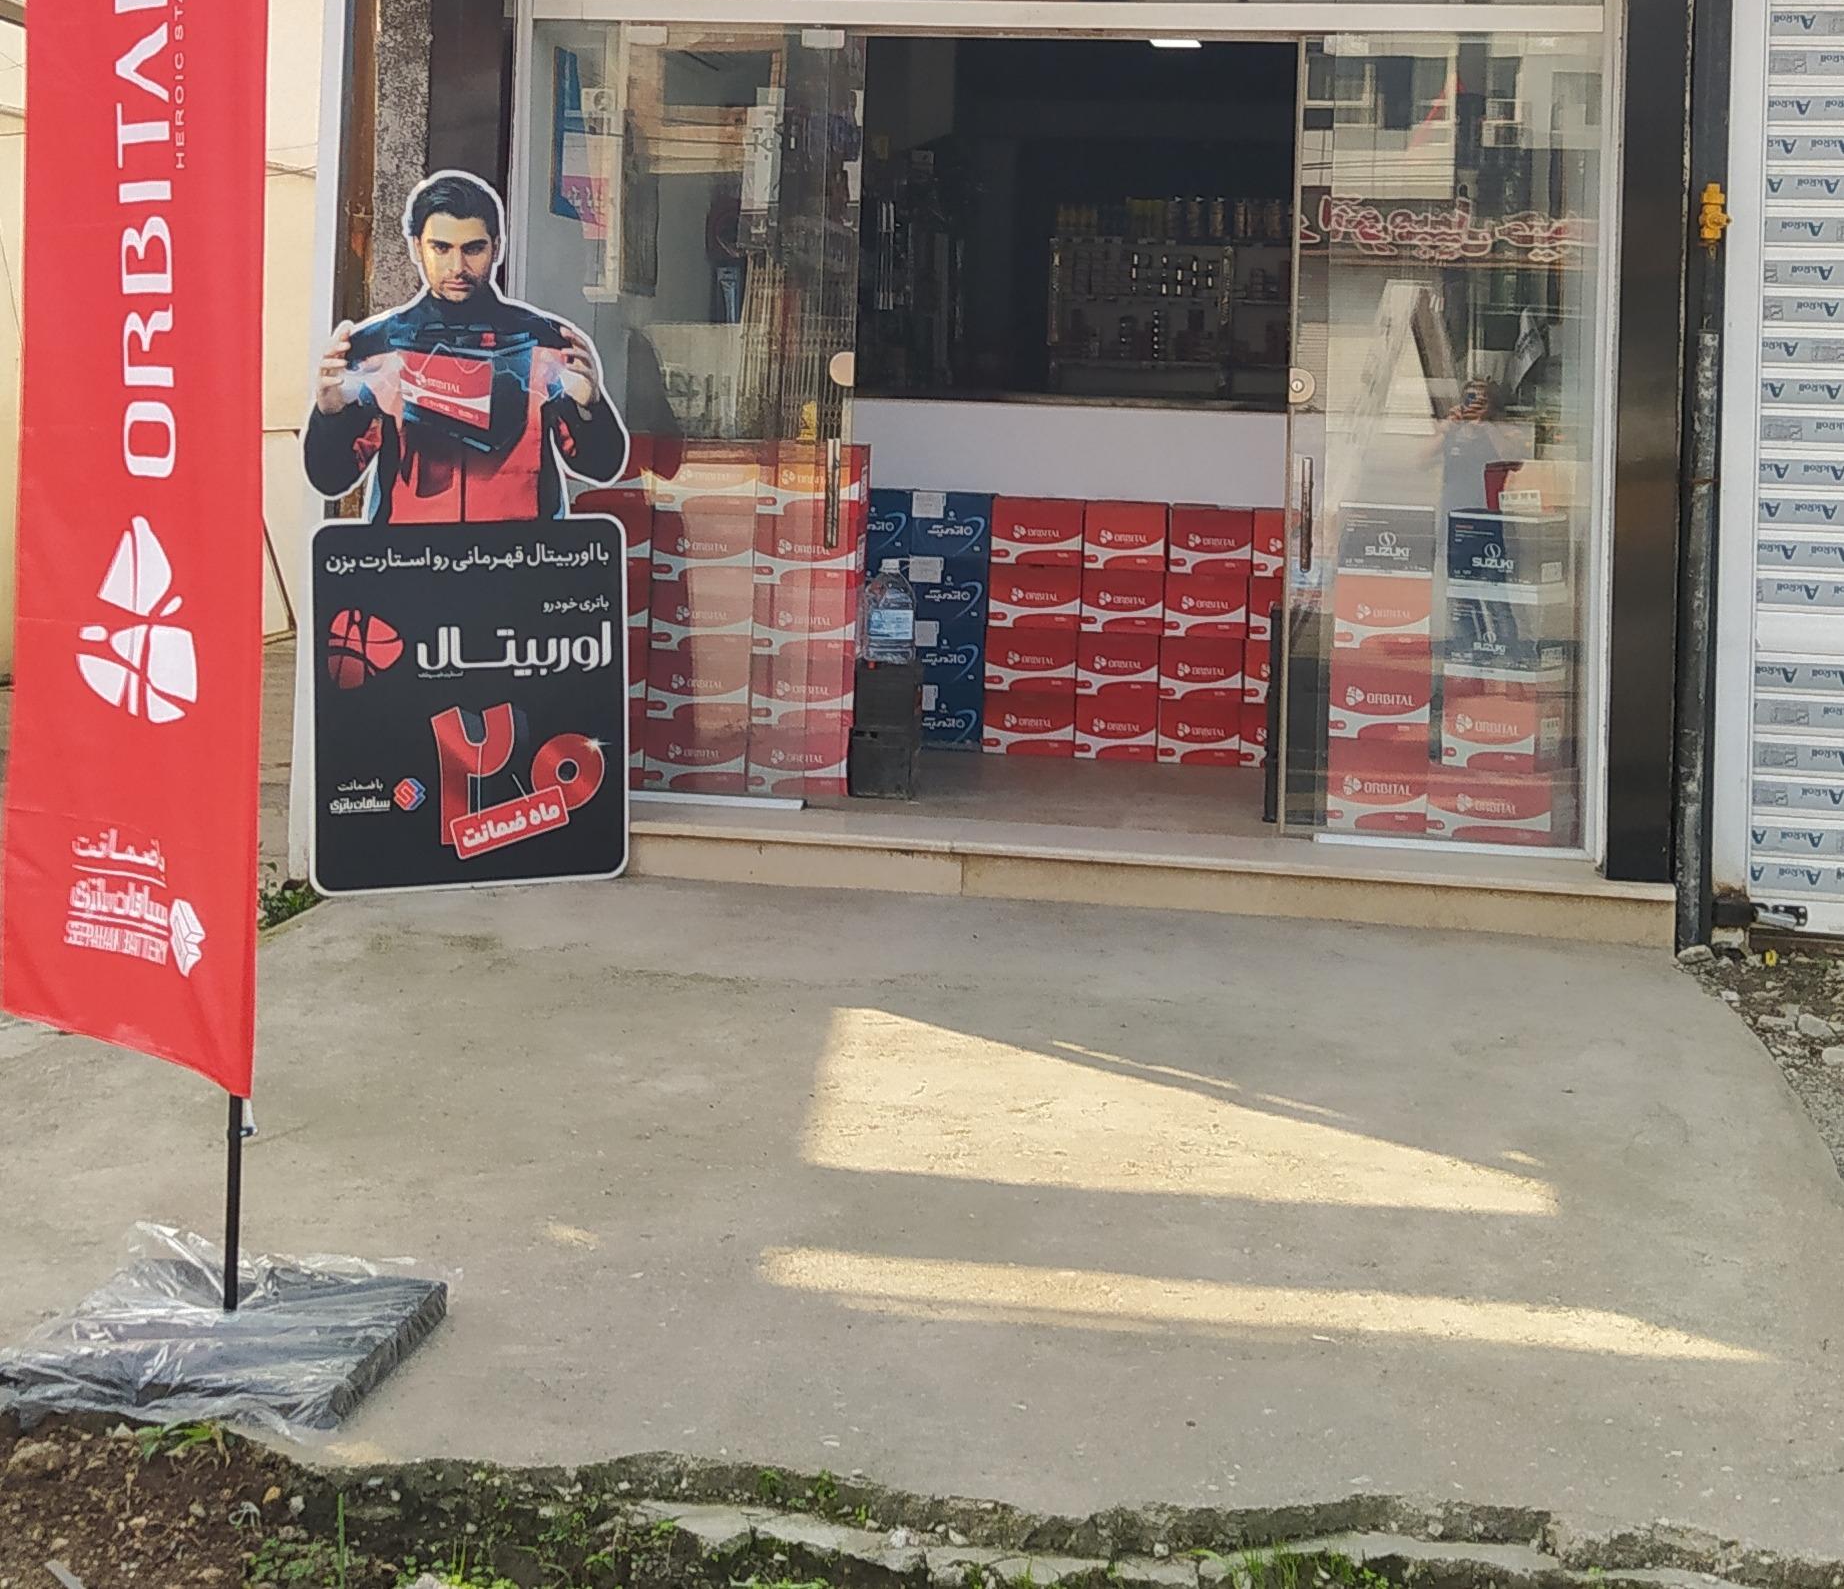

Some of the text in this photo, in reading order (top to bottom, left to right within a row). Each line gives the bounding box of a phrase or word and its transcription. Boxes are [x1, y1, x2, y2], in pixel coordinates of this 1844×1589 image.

[1773, 14, 1816, 30] AkRoll
[173, 51, 186, 169] HEROIC
[1797, 178, 1840, 194] AkRoll
[1781, 220, 1824, 236] AkRoll
[1791, 265, 1833, 281] AkRoll
[1797, 301, 1839, 317] AkRoll
[1799, 383, 1842, 400] AkRoll
[1795, 503, 1837, 520] AkRoll
[325, 541, 610, 576] با اوربیتال قهرمانی رو استارت بزن
[1364, 545, 1410, 558] SUZUKI
[1471, 556, 1514, 570] SUZUKI
[1777, 582, 1819, 600] AkRoll
[543, 594, 610, 614] باتری خودرو
[416, 620, 613, 677] اوربیتال
[1366, 691, 1416, 707] ORBITAL
[1474, 719, 1521, 737] ORBITAL
[336, 779, 375, 792] ضمانت
[1363, 781, 1413, 797] ORBITAL
[462, 802, 561, 848] ماه ضمانت
[1780, 831, 1823, 848] AkRoll
[1779, 867, 1821, 885] AkRoll
